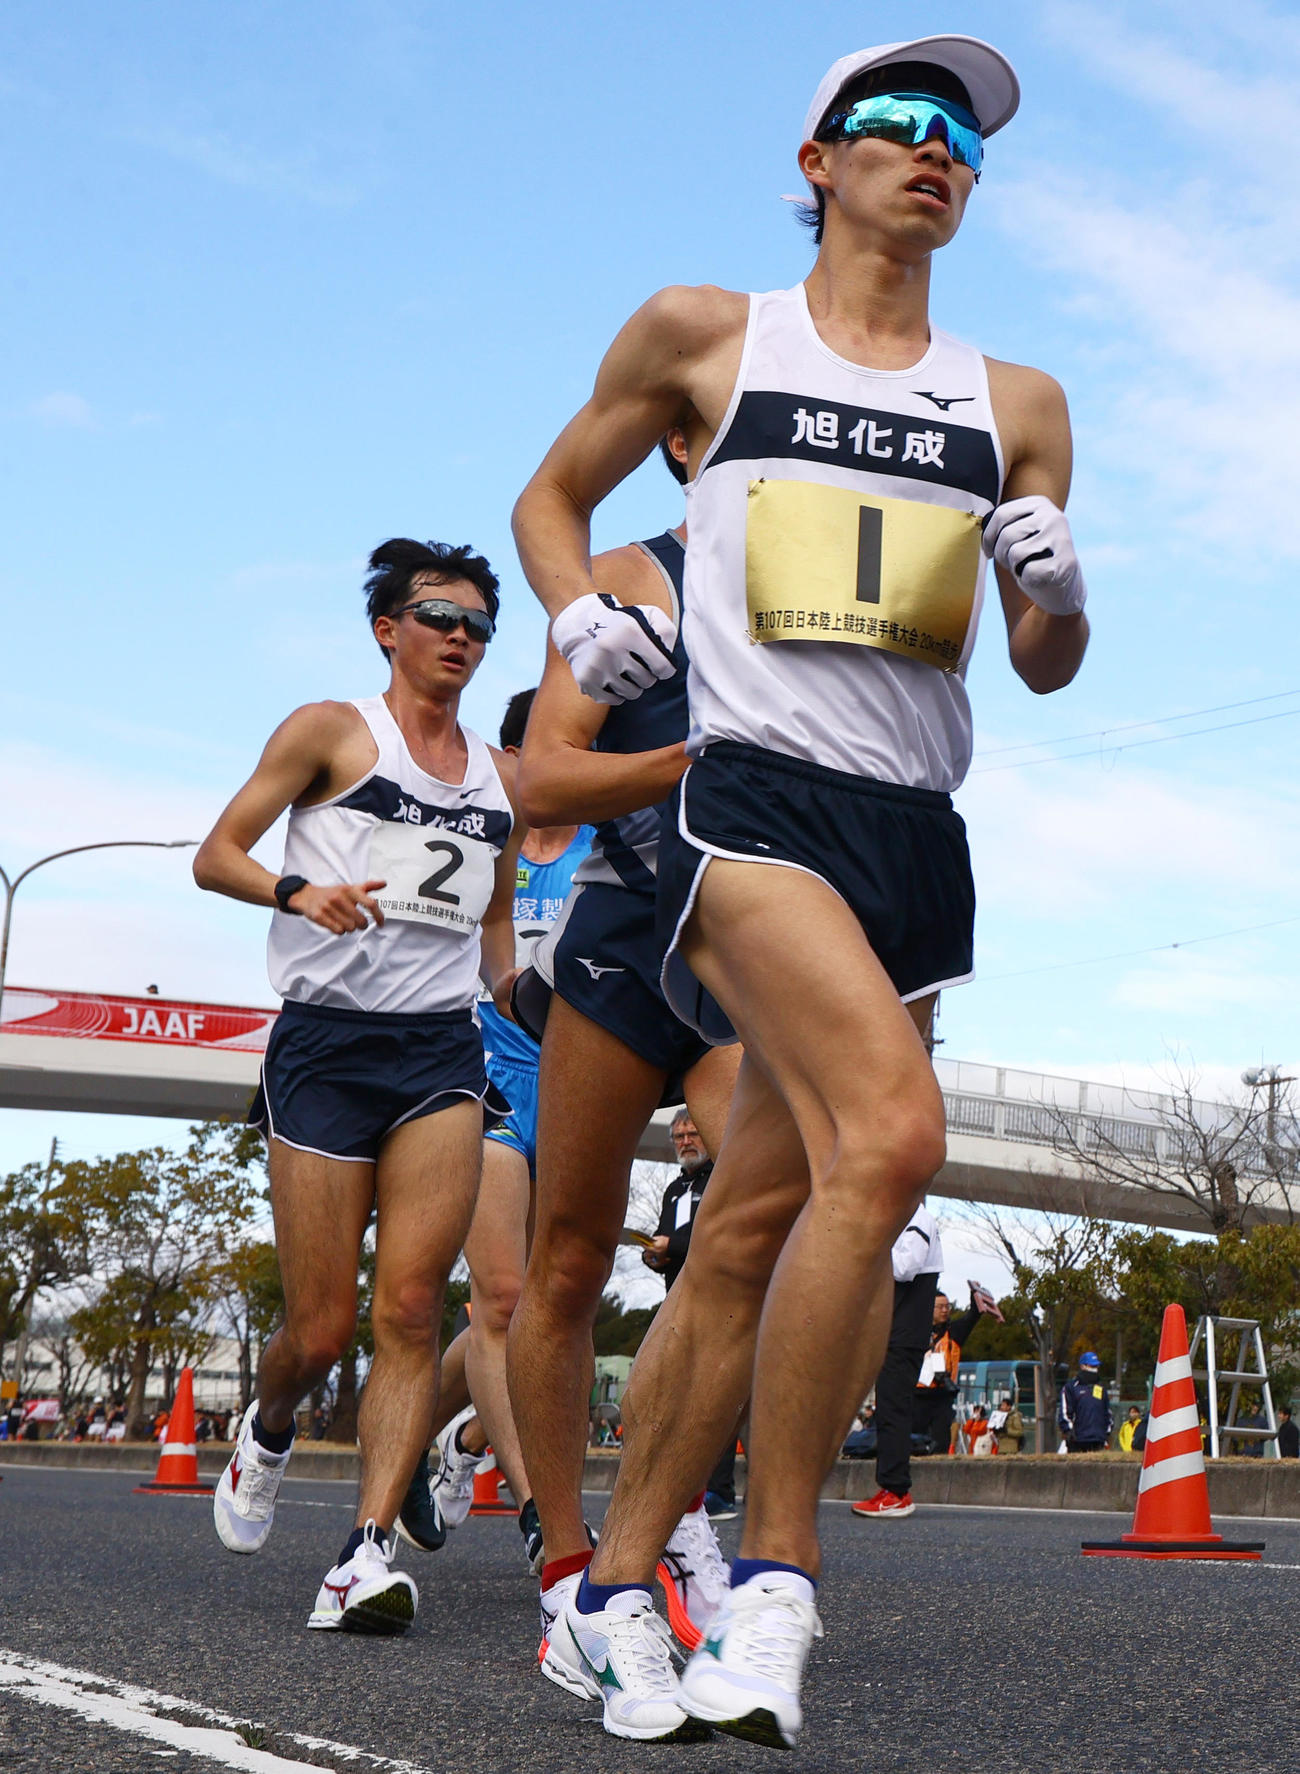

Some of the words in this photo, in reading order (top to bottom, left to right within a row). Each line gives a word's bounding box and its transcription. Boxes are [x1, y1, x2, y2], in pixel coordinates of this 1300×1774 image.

[791, 408, 945, 470] 旭化成
[856, 505, 882, 604] 1
[754, 610, 919, 646] 第107回日本陸上競技選手権大会
[418, 840, 464, 905] 2
[376, 899, 465, 923] 107回日本陸上競技選手権大会
[122, 1007, 205, 1038] JAAF
